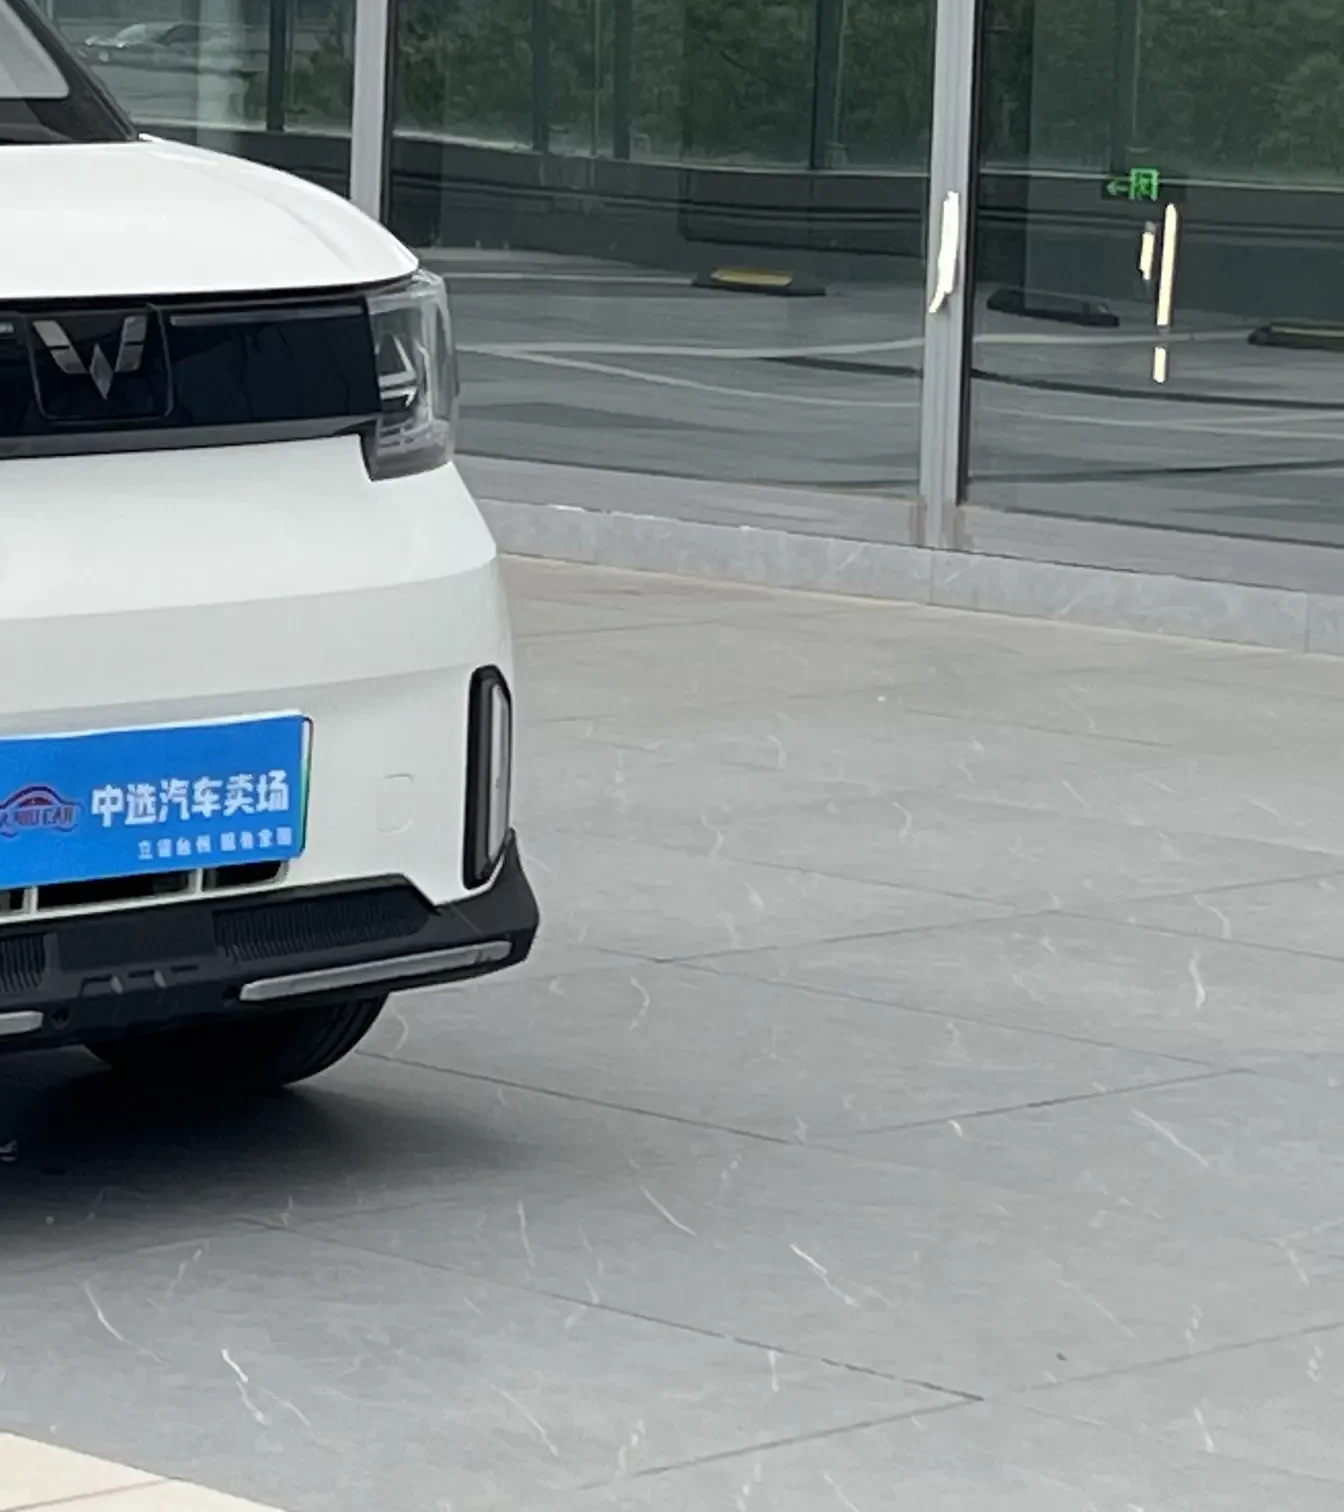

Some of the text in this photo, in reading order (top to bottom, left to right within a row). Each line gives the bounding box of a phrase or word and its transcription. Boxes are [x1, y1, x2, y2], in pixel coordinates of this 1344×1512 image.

[91, 769, 289, 828] 中选汽车卖场
